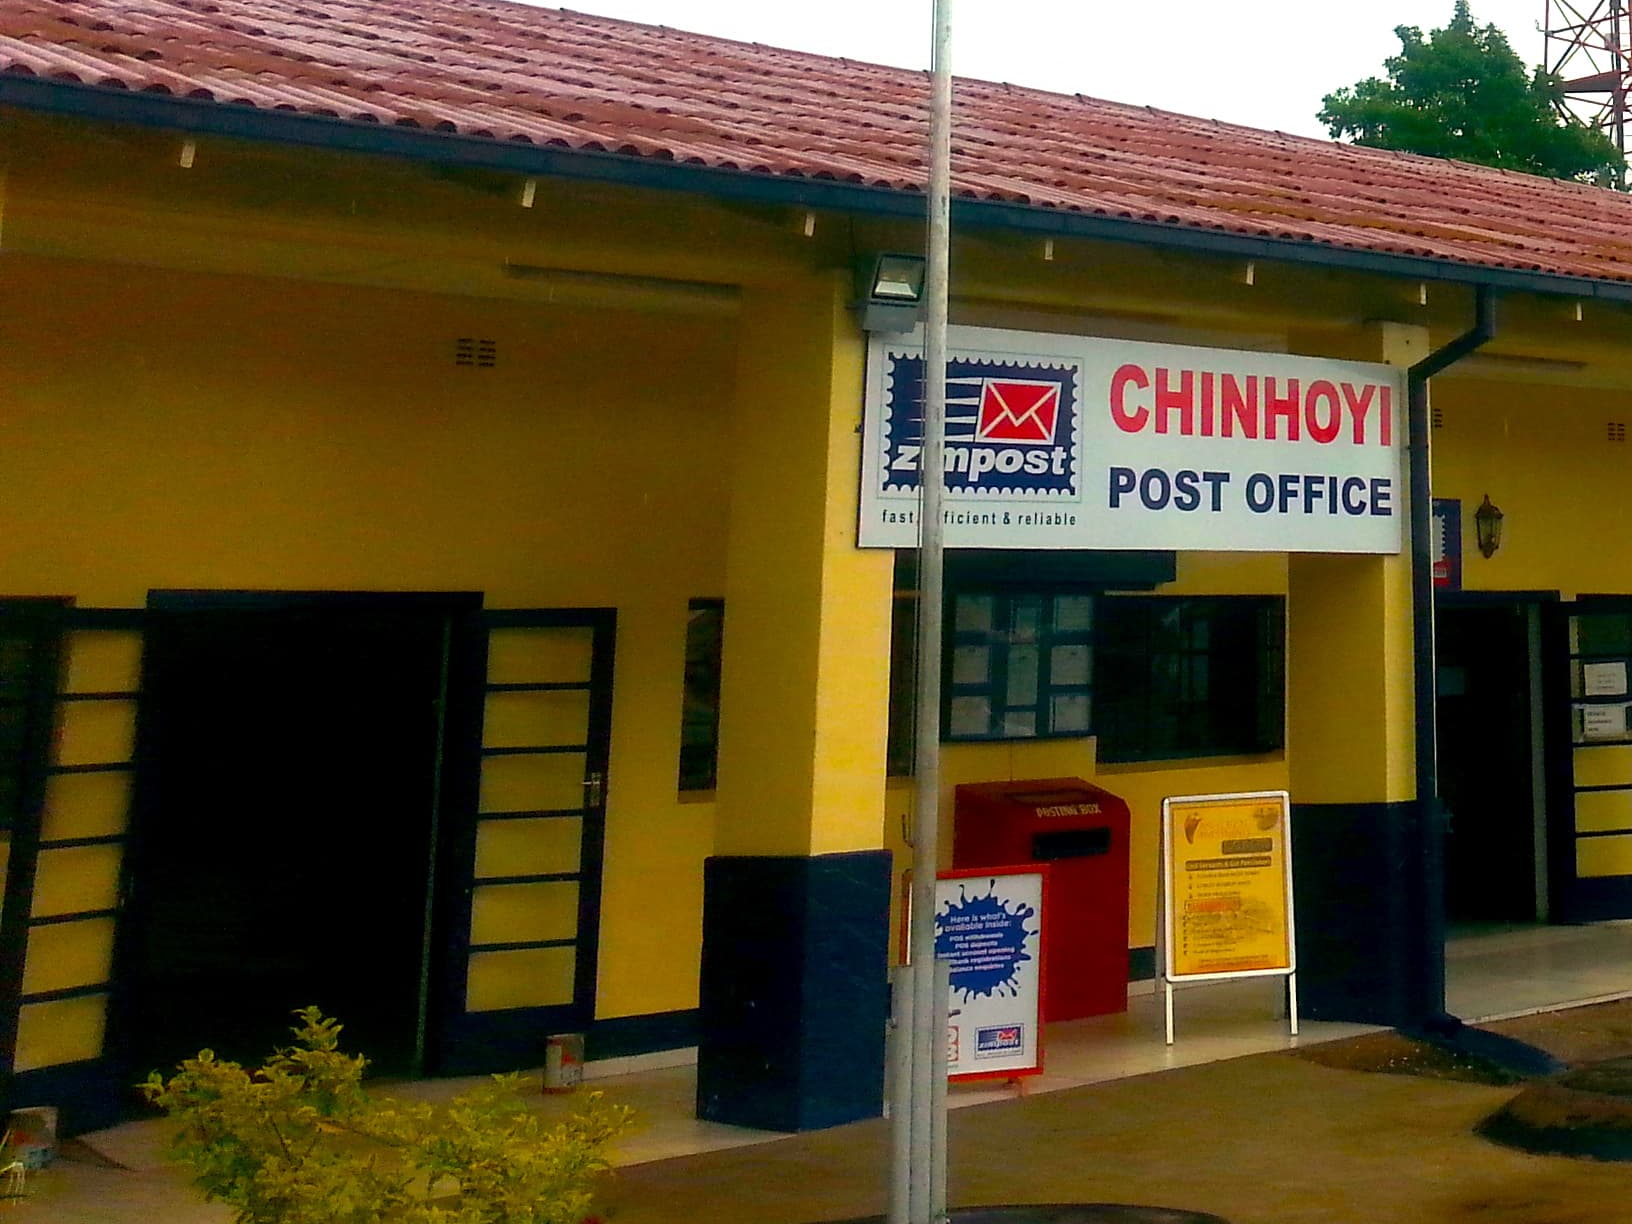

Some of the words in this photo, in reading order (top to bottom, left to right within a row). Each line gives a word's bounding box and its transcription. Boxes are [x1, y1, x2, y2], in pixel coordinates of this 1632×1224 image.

[1109, 363, 1392, 447] CHINHOYI
[891, 444, 1067, 482] zmpost
[1109, 466, 1230, 512] POST
[1245, 472, 1392, 517] OFFICE
[943, 511, 996, 525] ficient
[1002, 512, 1011, 525] &
[1018, 512, 1076, 525] reliable
